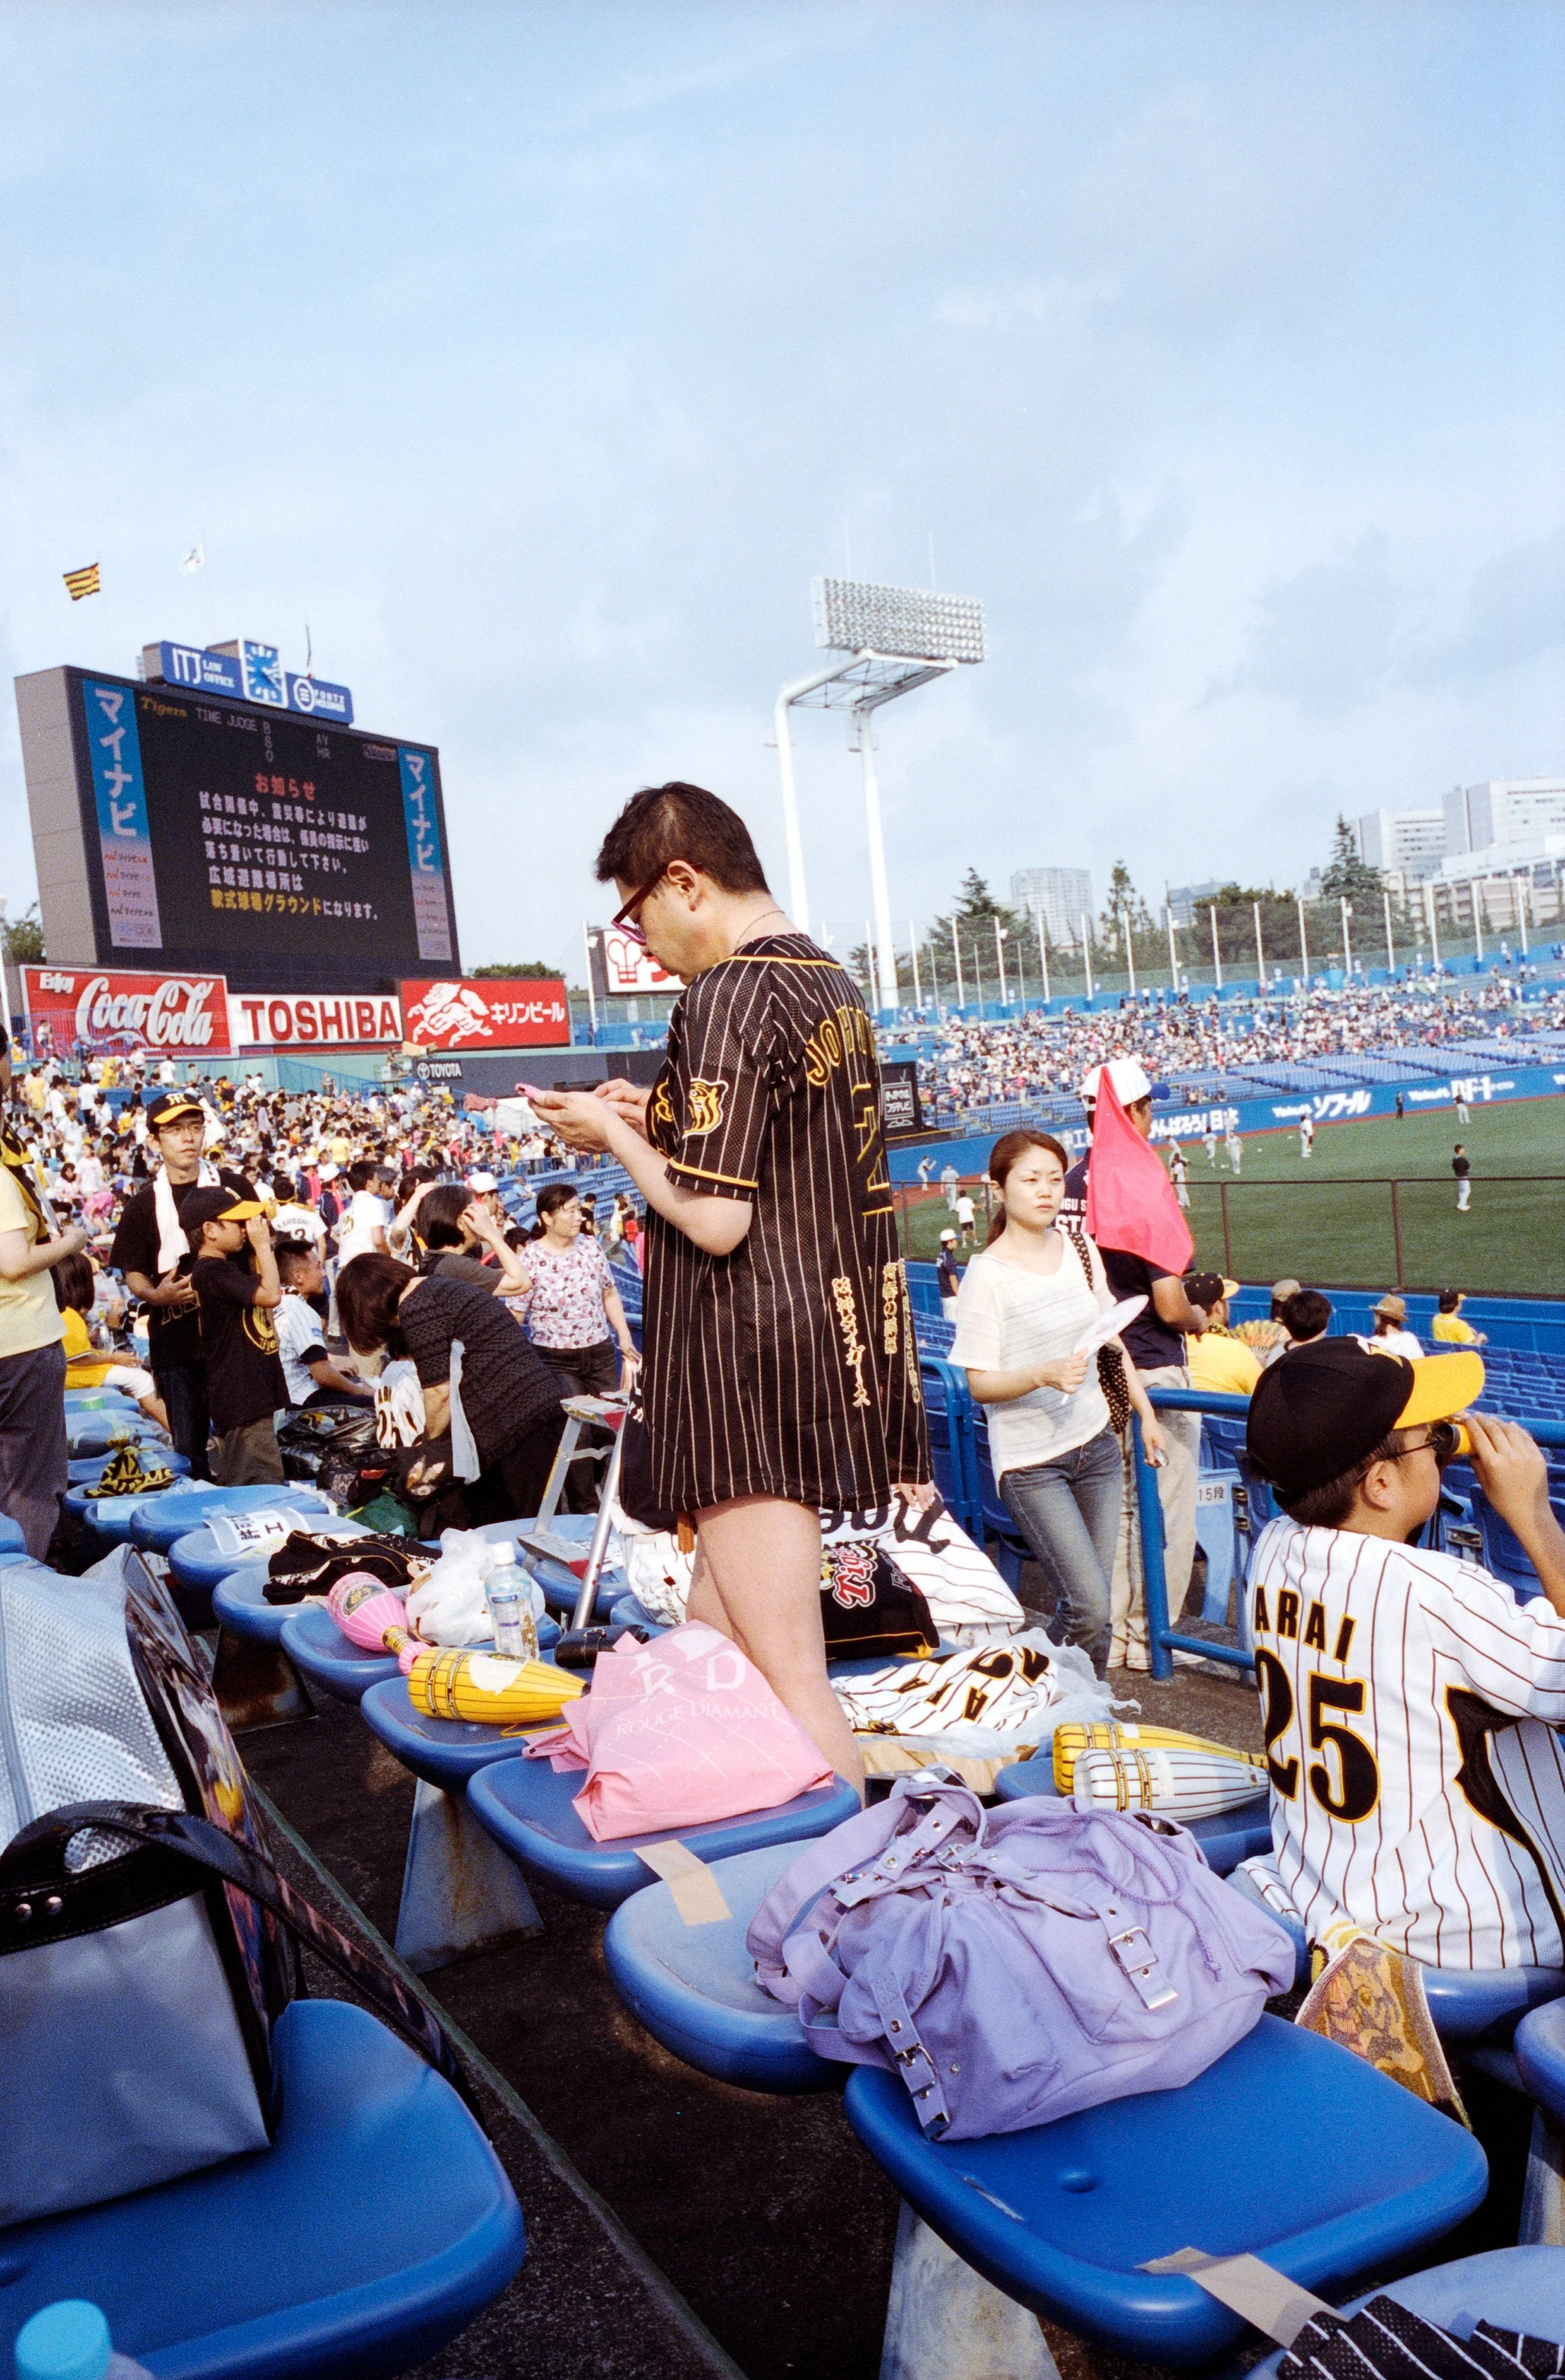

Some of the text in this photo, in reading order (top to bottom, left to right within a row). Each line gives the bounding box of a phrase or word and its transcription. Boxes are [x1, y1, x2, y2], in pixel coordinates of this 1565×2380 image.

[172, 647, 202, 684] ITJ
[202, 659, 222, 672] LAW
[203, 672, 235, 688] OFFICE
[140, 696, 188, 718] Tigers
[195, 707, 222, 724] TIME
[95, 688, 137, 837] マイナビ
[255, 771, 316, 801] お知らせ
[406, 754, 434, 872] マイナビ
[39, 972, 75, 994] Enjoy
[74, 976, 215, 1047] Coca-Cola
[239, 1000, 399, 1042] TOSHIBA
[490, 1001, 565, 1025] キリンビール
[429, 1063, 462, 1078] TOYOTA
[1313, 1090, 1372, 1119] ソフール
[1255, 1584, 1357, 1666] ARAI
[617, 1701, 780, 1738] ROUGE DIAMANT
[1253, 1646, 1382, 1824] 25
